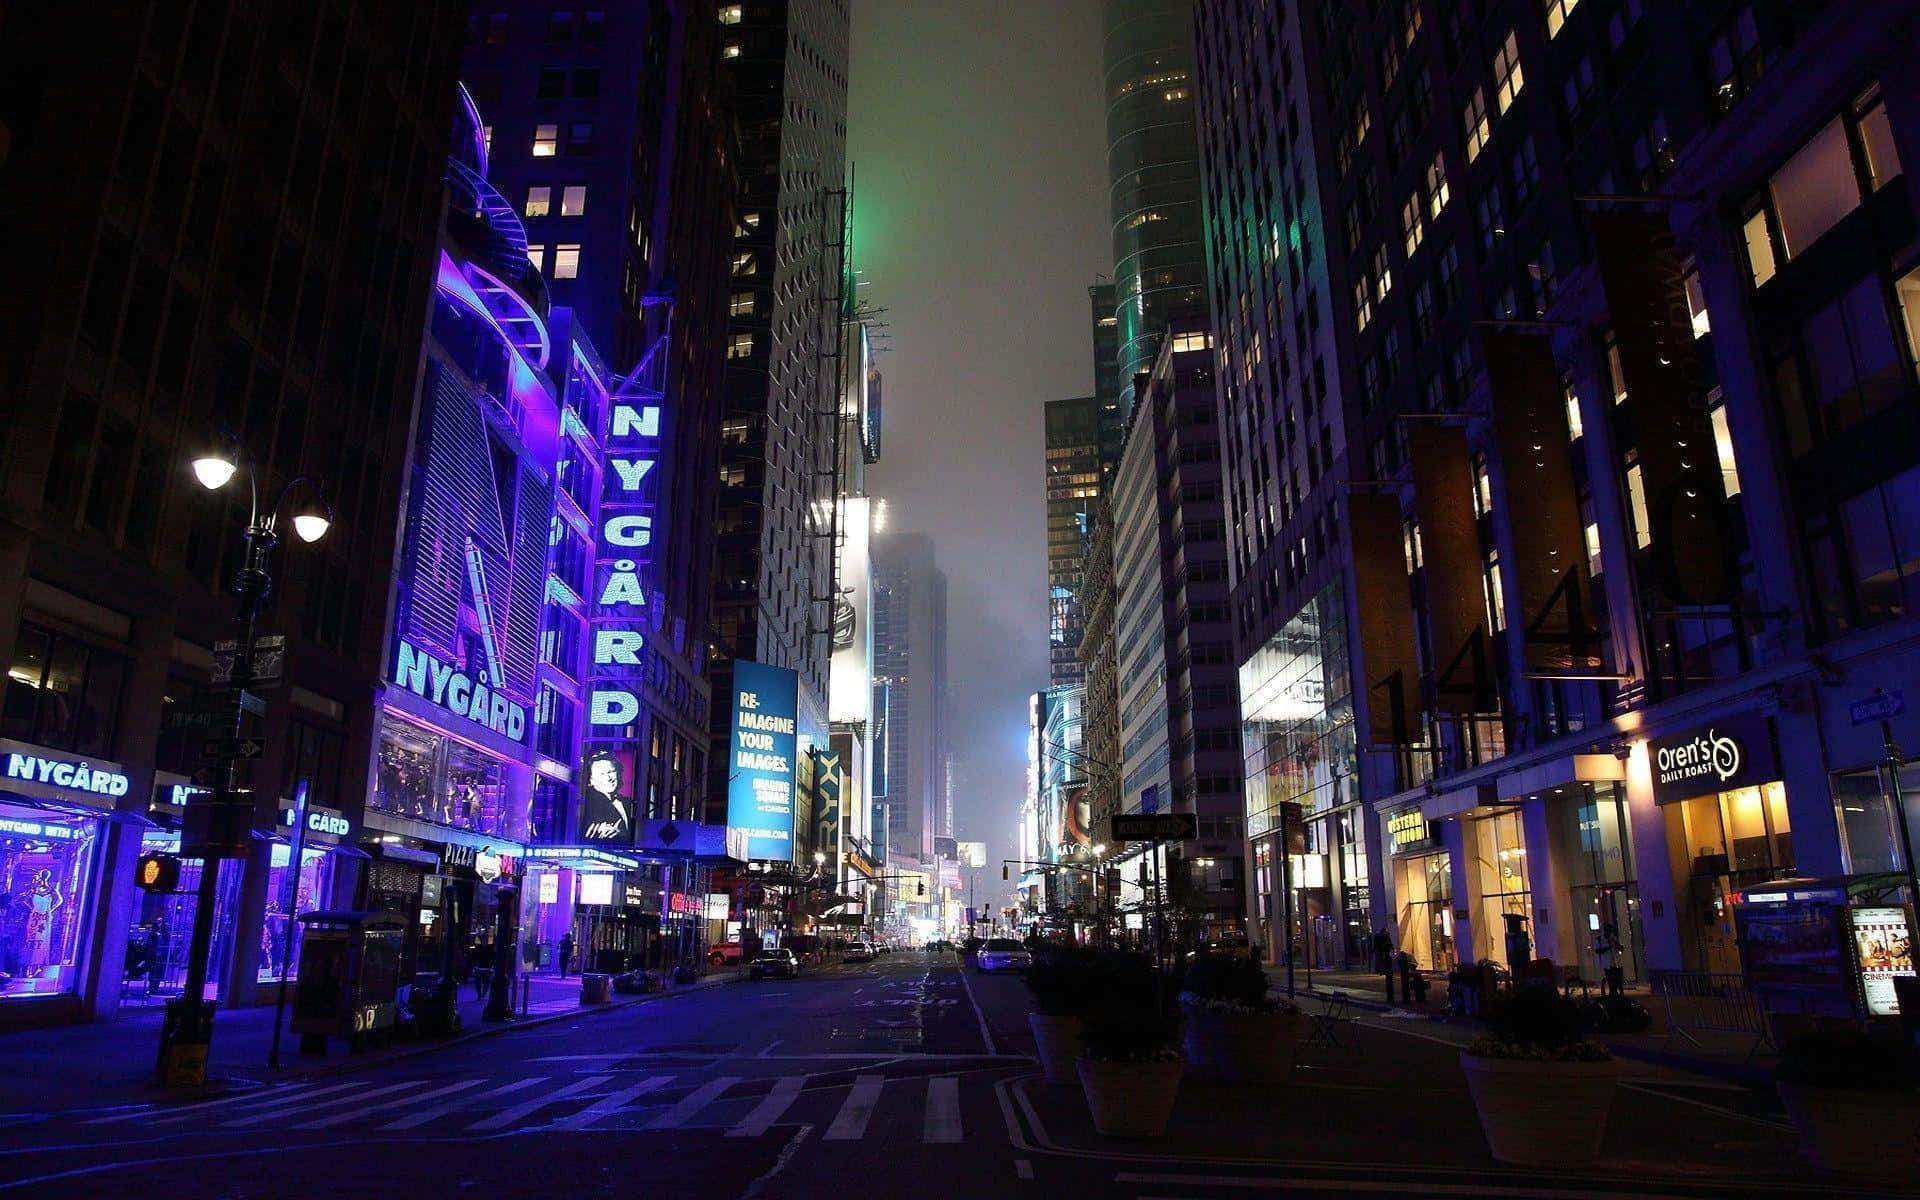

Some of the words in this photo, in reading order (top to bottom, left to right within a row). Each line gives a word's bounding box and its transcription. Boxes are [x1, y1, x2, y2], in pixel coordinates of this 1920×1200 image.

[591, 405, 660, 725] NYGÅRD
[394, 640, 525, 742] NYGÅRD
[740, 692, 760, 708] RE-
[739, 711, 794, 734] IMAGINE
[738, 731, 774, 751] YOUR
[1658, 736, 1711, 771] Oren's
[737, 751, 790, 773] IMAGES.
[1660, 769, 1683, 784] DAILY
[1684, 761, 1713, 778] ROAST
[7, 753, 129, 797] NYGÅRD
[286, 808, 350, 836] NGÅRD
[444, 842, 475, 867] PIZZA
